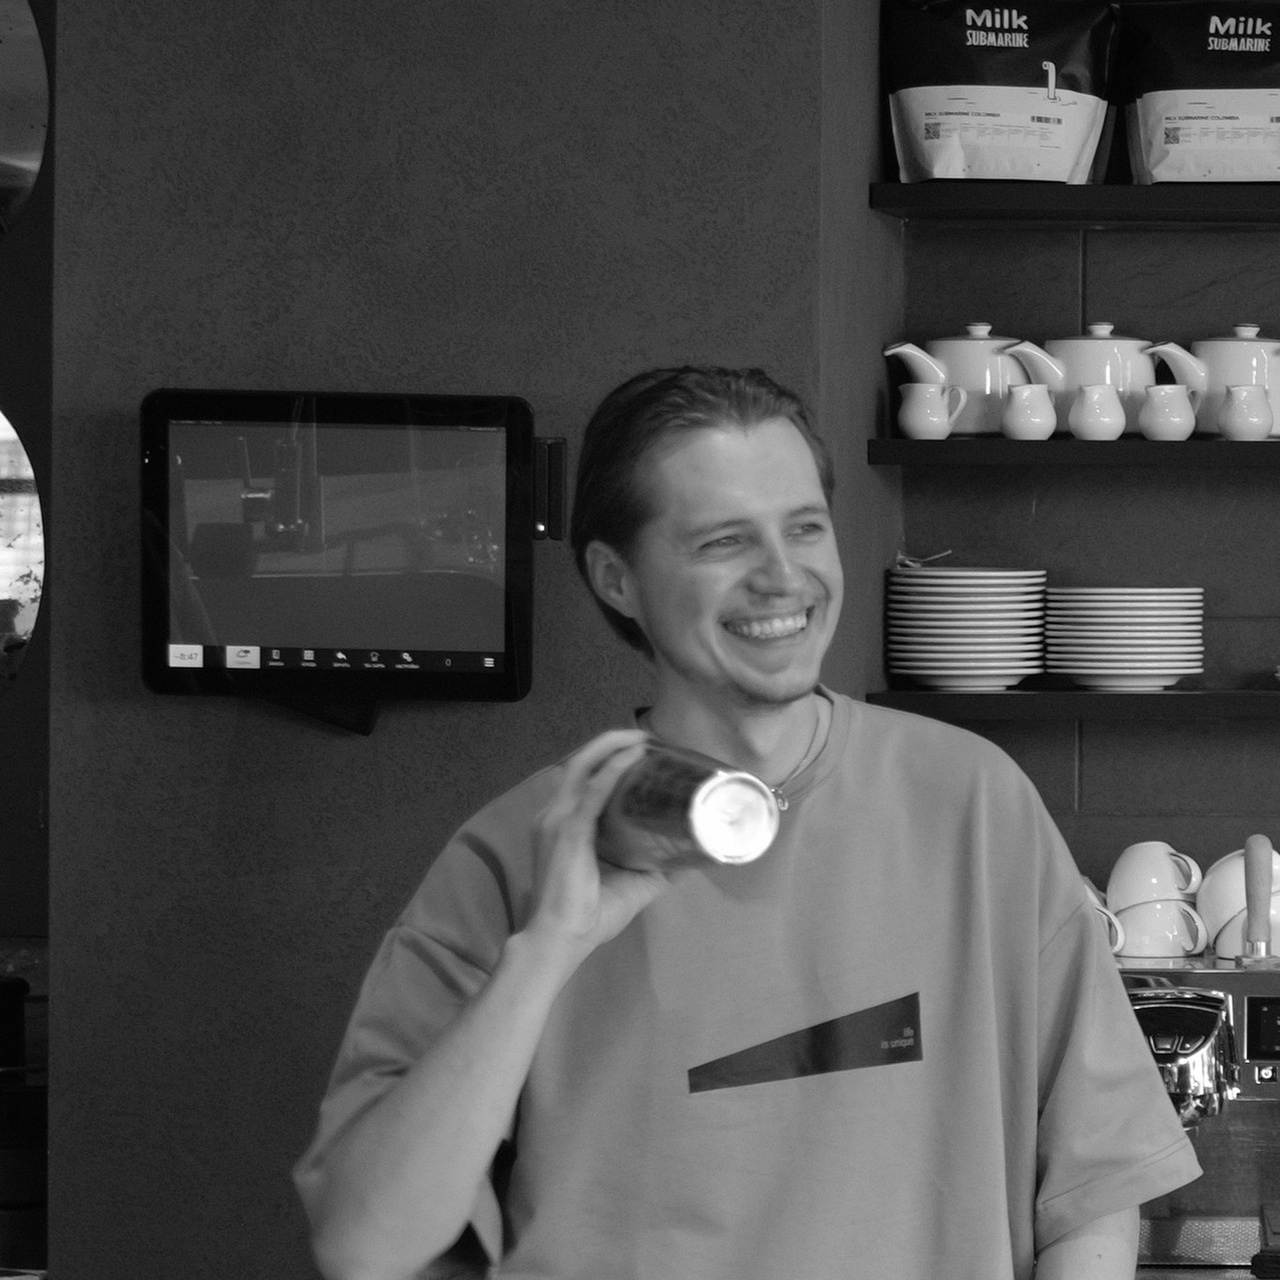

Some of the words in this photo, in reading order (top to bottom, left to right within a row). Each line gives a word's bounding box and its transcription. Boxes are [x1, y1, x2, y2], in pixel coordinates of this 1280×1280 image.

[965, 8, 1029, 30] Milk
[1208, 15, 1273, 35] Milk
[965, 30, 1030, 48] SUBMARINE
[1207, 37, 1271, 52] SUBMARINE
